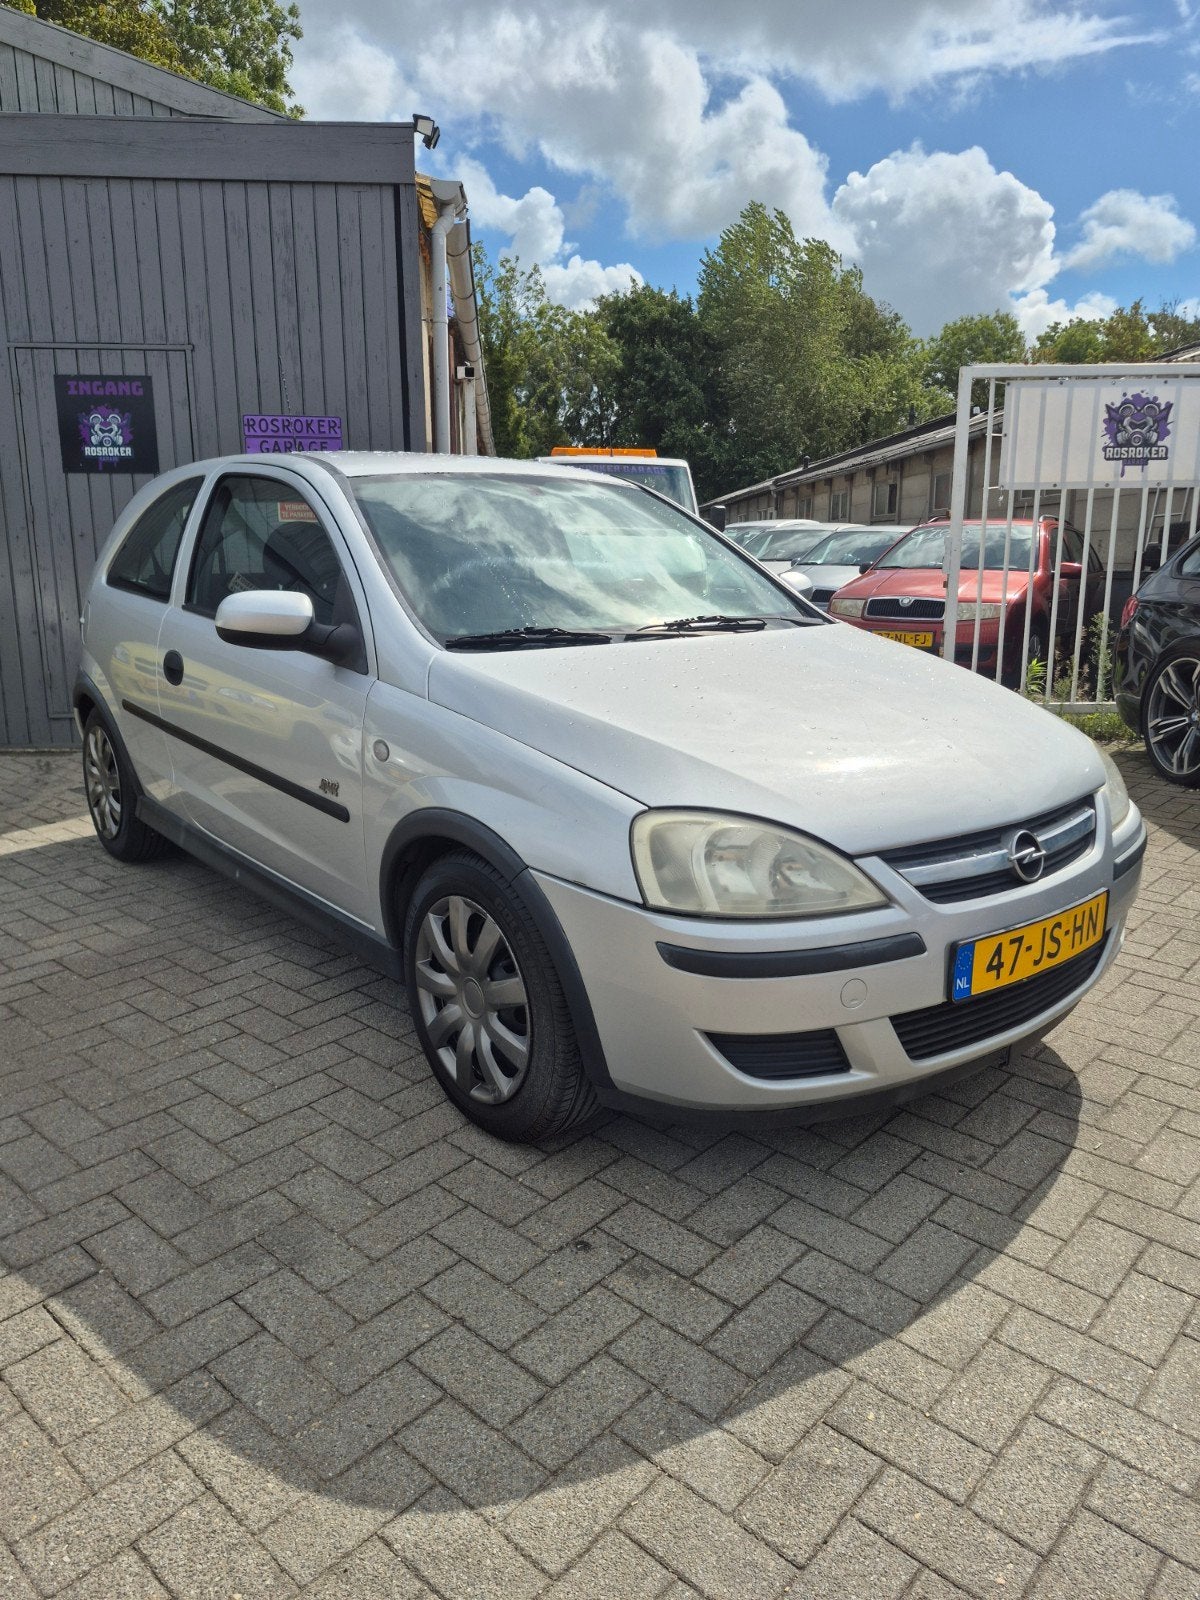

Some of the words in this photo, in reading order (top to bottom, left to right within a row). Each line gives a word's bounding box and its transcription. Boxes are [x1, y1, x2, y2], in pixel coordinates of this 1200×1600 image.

[67, 381, 144, 396] INGANG
[247, 418, 338, 434] ROSROKER
[84, 446, 132, 456] ROSROKER
[260, 440, 328, 453] GARAGE
[1106, 447, 1166, 458] ROSROKER
[986, 903, 1100, 980] 47-JS-HN
[956, 977, 970, 990] NL
